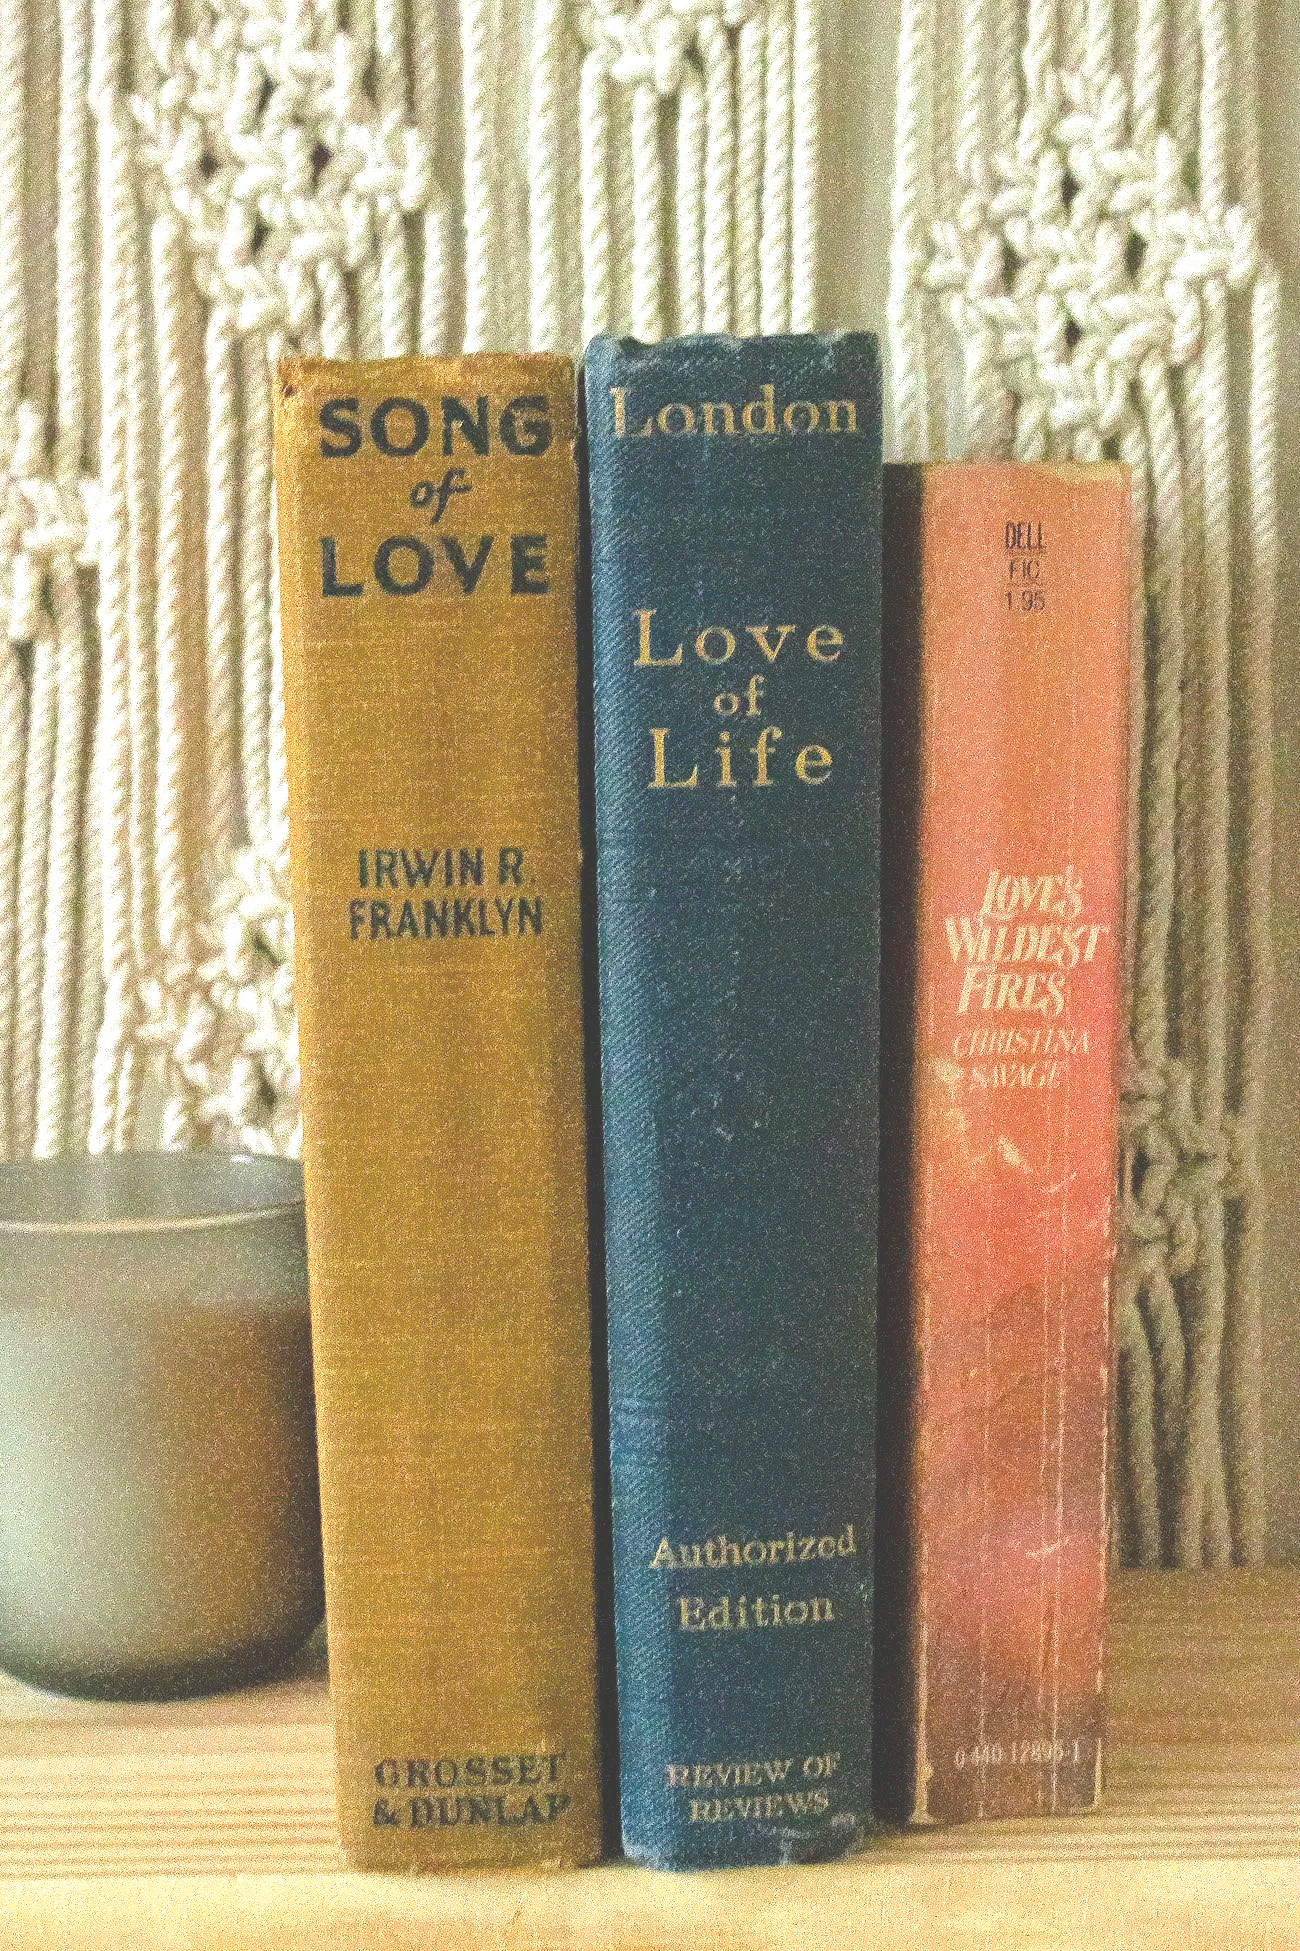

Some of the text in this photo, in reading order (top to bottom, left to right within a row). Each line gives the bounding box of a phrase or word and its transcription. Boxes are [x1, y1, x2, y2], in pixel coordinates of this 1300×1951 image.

[319, 395, 551, 458] SONG
[609, 384, 858, 438] London
[410, 467, 472, 525] of
[1005, 520, 1046, 550] DELL
[320, 534, 550, 597] LOVE
[1008, 558, 1040, 580] FIC
[633, 608, 844, 667] Love
[714, 675, 765, 717] of
[647, 726, 833, 789] Life
[358, 848, 483, 888] IRWIN
[979, 864, 1083, 921] LOVE'S
[349, 898, 543, 940] FRANKLYN
[944, 915, 1111, 969] WILDEST
[956, 964, 1066, 1017] FIRES
[952, 1028, 1090, 1057] CHRISTINA
[968, 1060, 1062, 1091] SAVAGE
[650, 1523, 857, 1568] Authorized
[679, 1594, 835, 1631] Edition
[373, 1752, 567, 1788] GROSSET
[666, 1751, 841, 1788] REVIEW OF
[372, 1793, 573, 1828] & DUNLAP
[688, 1788, 830, 1823] REVIEWS
